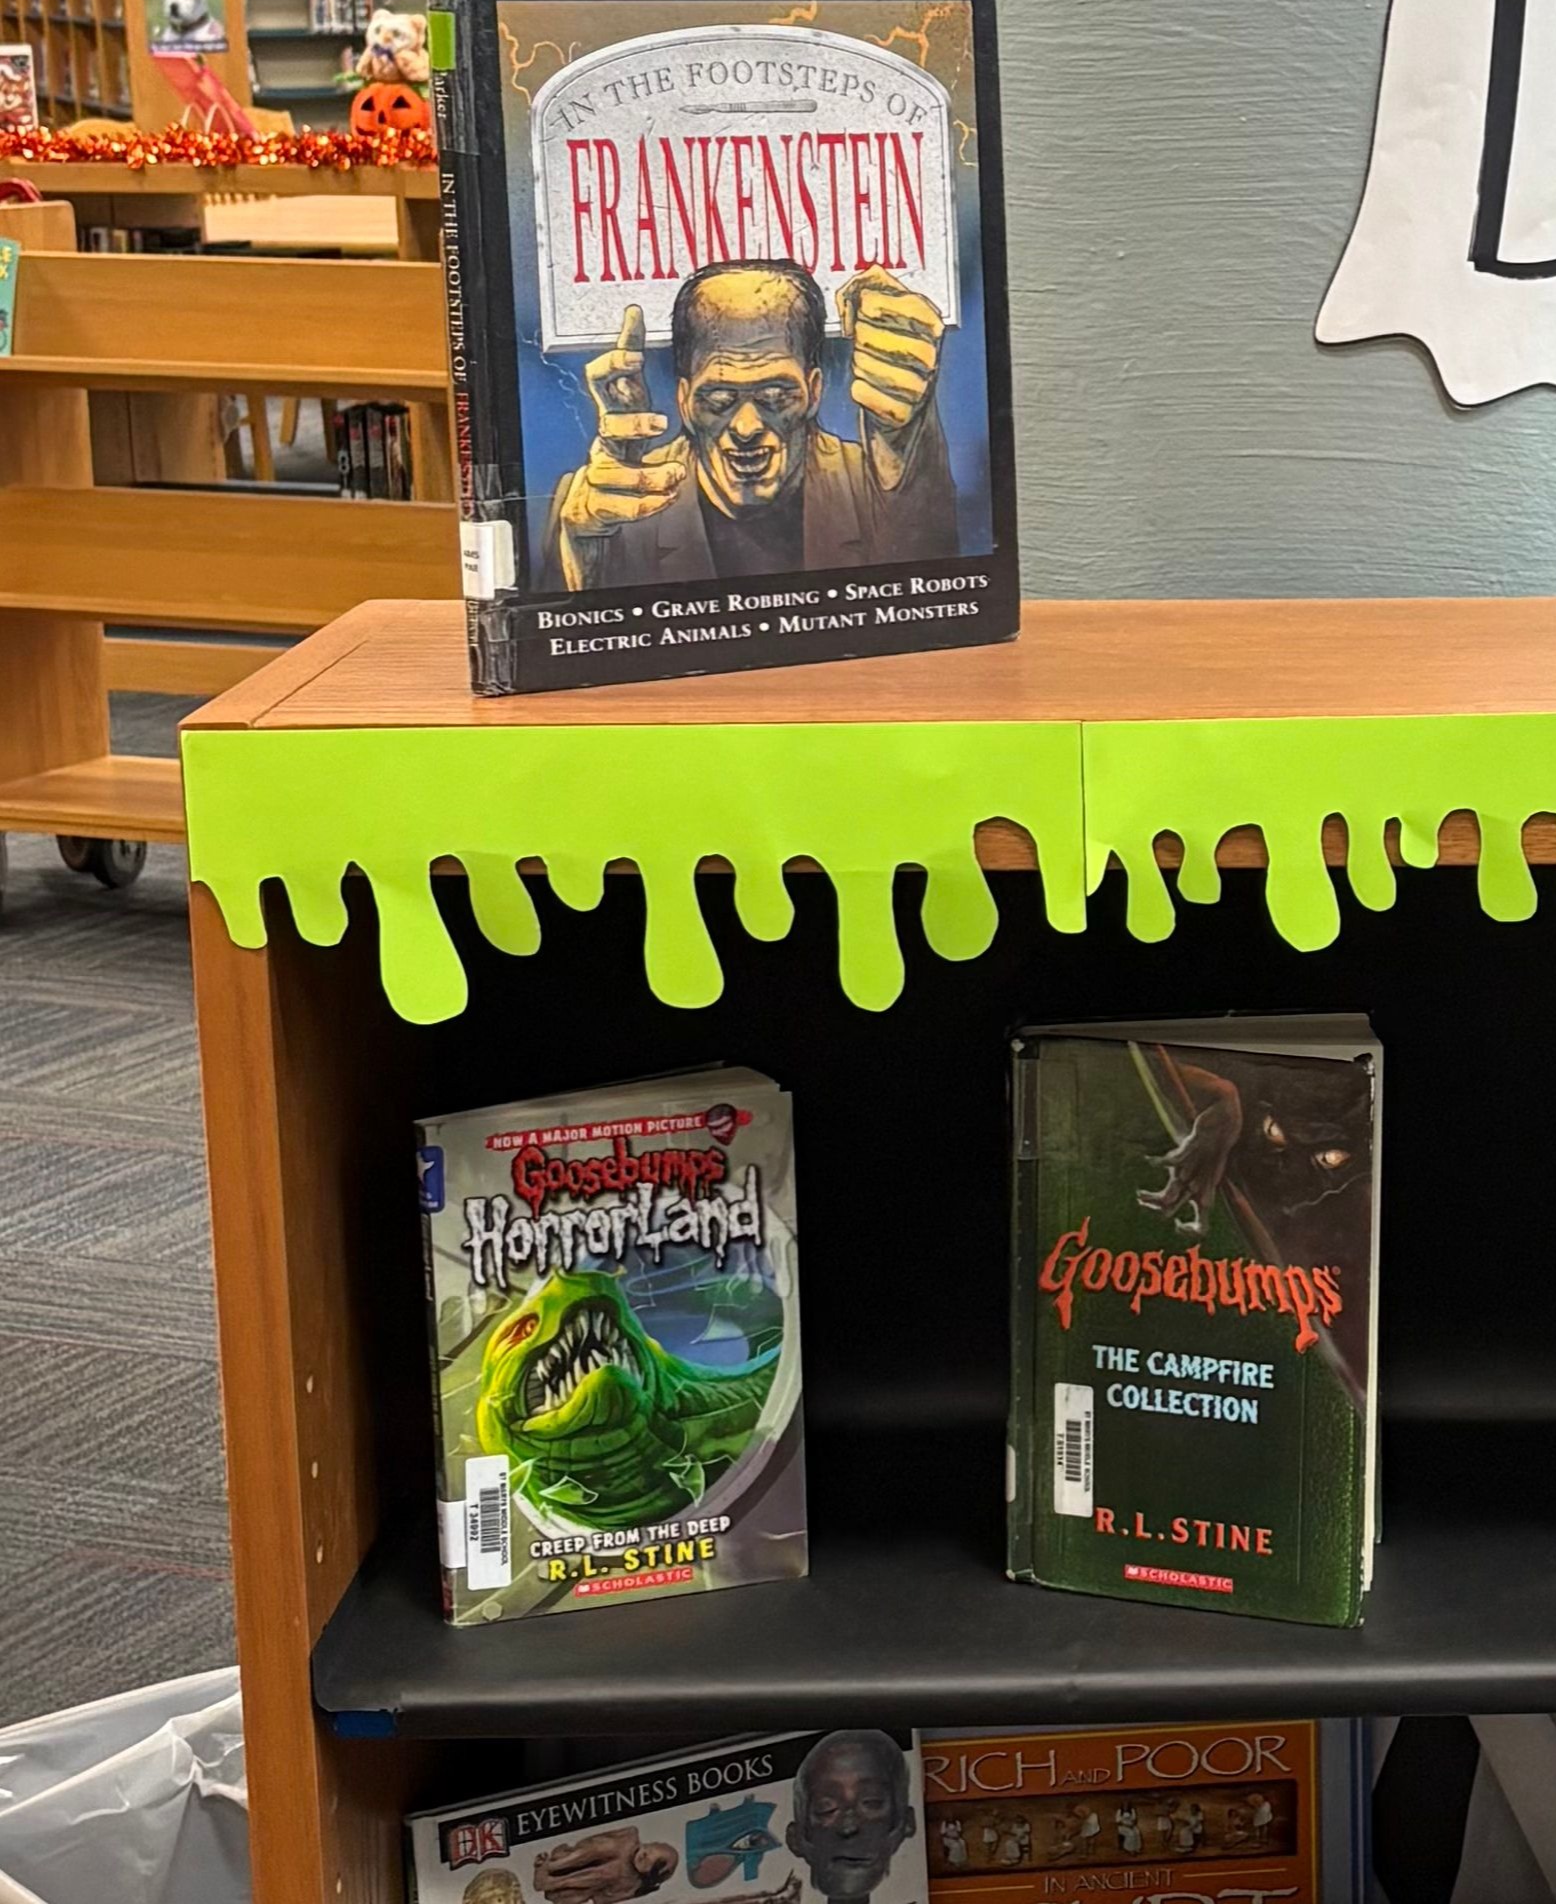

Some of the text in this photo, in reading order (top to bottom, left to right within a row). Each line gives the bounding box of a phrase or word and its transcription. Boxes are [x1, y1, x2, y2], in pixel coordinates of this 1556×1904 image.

[557, 58, 929, 133] IN THE FOOTSTEPS OF
[565, 130, 926, 284] FRANKENSTEIN
[536, 573, 989, 630] BIONICS GRAVE ROBBING SPACE ROBOTS
[549, 600, 980, 657] ELECTRIC ANIMALS MUTANT MONSTERS
[493, 1115, 702, 1149] NOW A MAJOR MOTION PICTURE
[511, 1136, 728, 1222] Goosebumps
[1038, 1215, 1343, 1354] Goosebumps
[1092, 1344, 1275, 1389] THE CAMPFIRE
[1106, 1382, 1259, 1425] COLLECTION
[529, 1515, 732, 1558] CREEP FROM THE DEEP
[549, 1537, 716, 1581] R.L. STINE
[588, 1567, 693, 1592] SCHOLASTIC
[1139, 1568, 1233, 1592] SCHOLASTIC
[922, 1734, 1293, 1794] RICH AND POOR
[516, 1753, 775, 1837] EYEWITNESS BOOKS
[1043, 1868, 1175, 1894] IN ANCIENT
